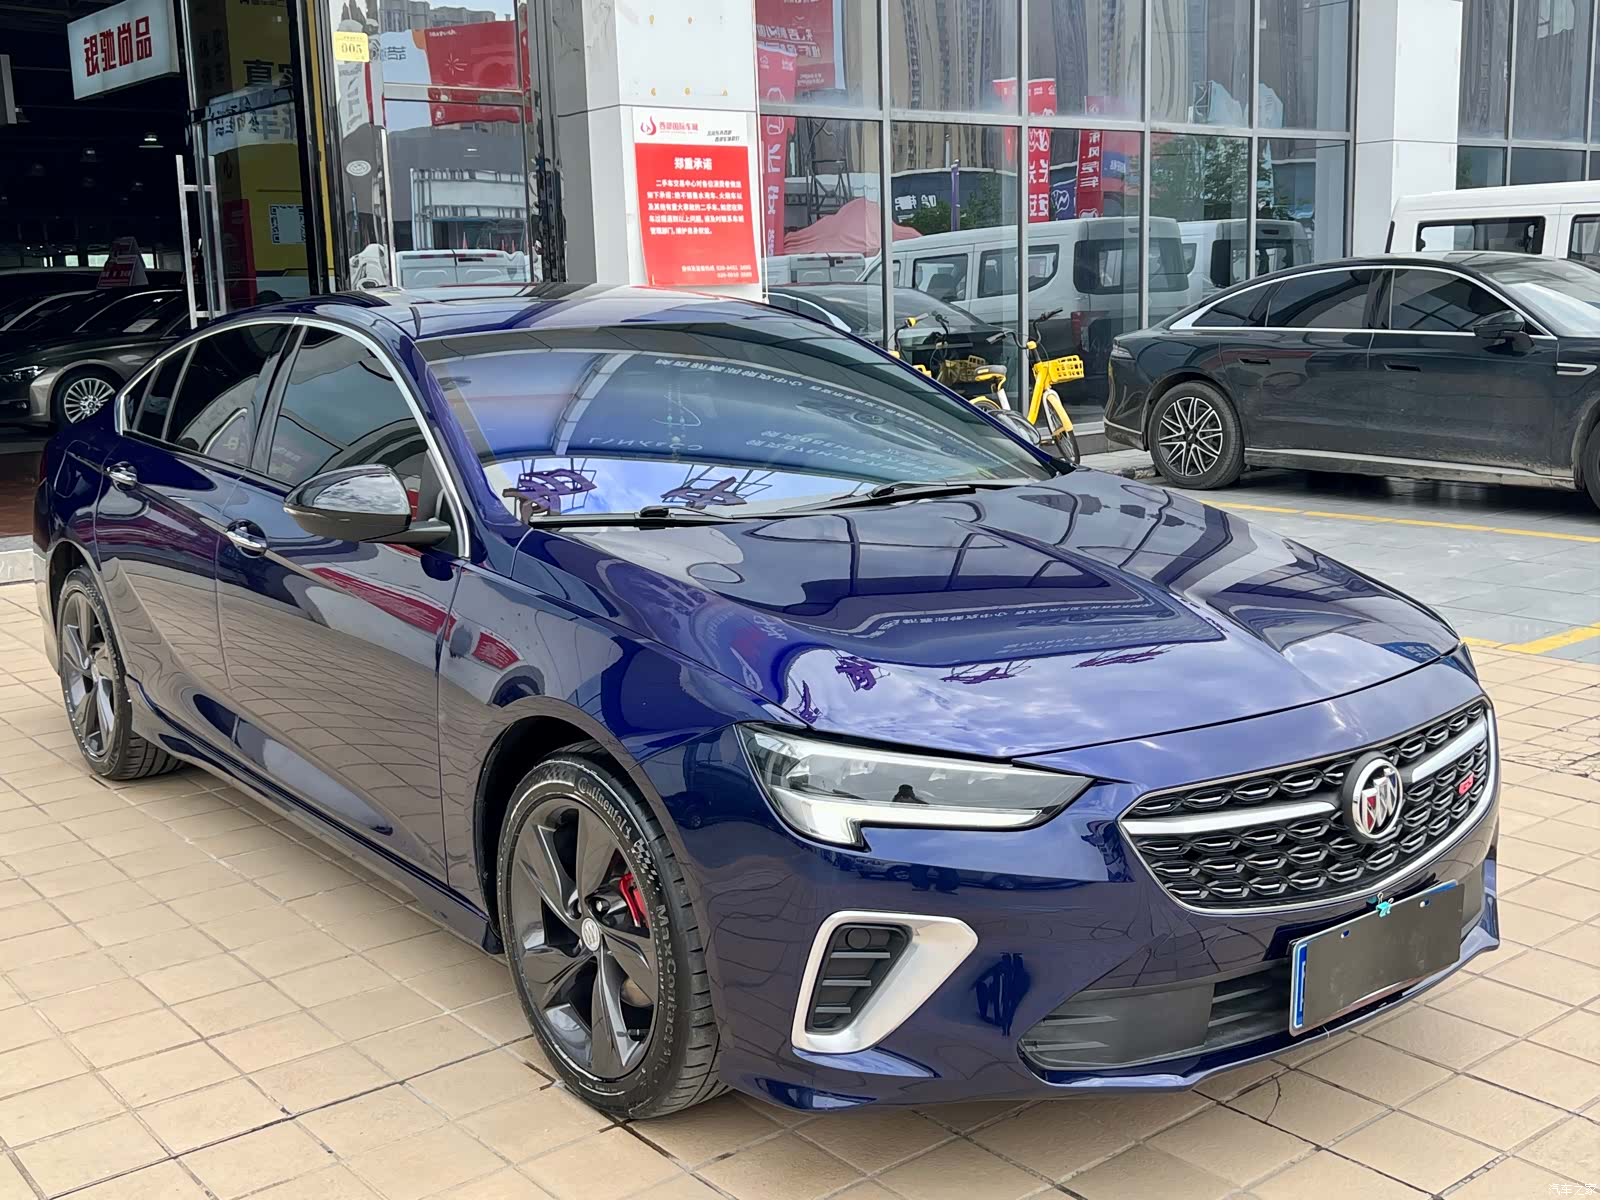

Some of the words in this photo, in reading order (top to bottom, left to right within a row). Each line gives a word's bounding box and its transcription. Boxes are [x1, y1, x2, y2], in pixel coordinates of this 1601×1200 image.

[84, 16, 153, 77] 银驰尚品
[674, 157, 713, 170] 郑重承诺
[577, 777, 627, 832] Continental
[657, 905, 677, 1042] MaxContact
